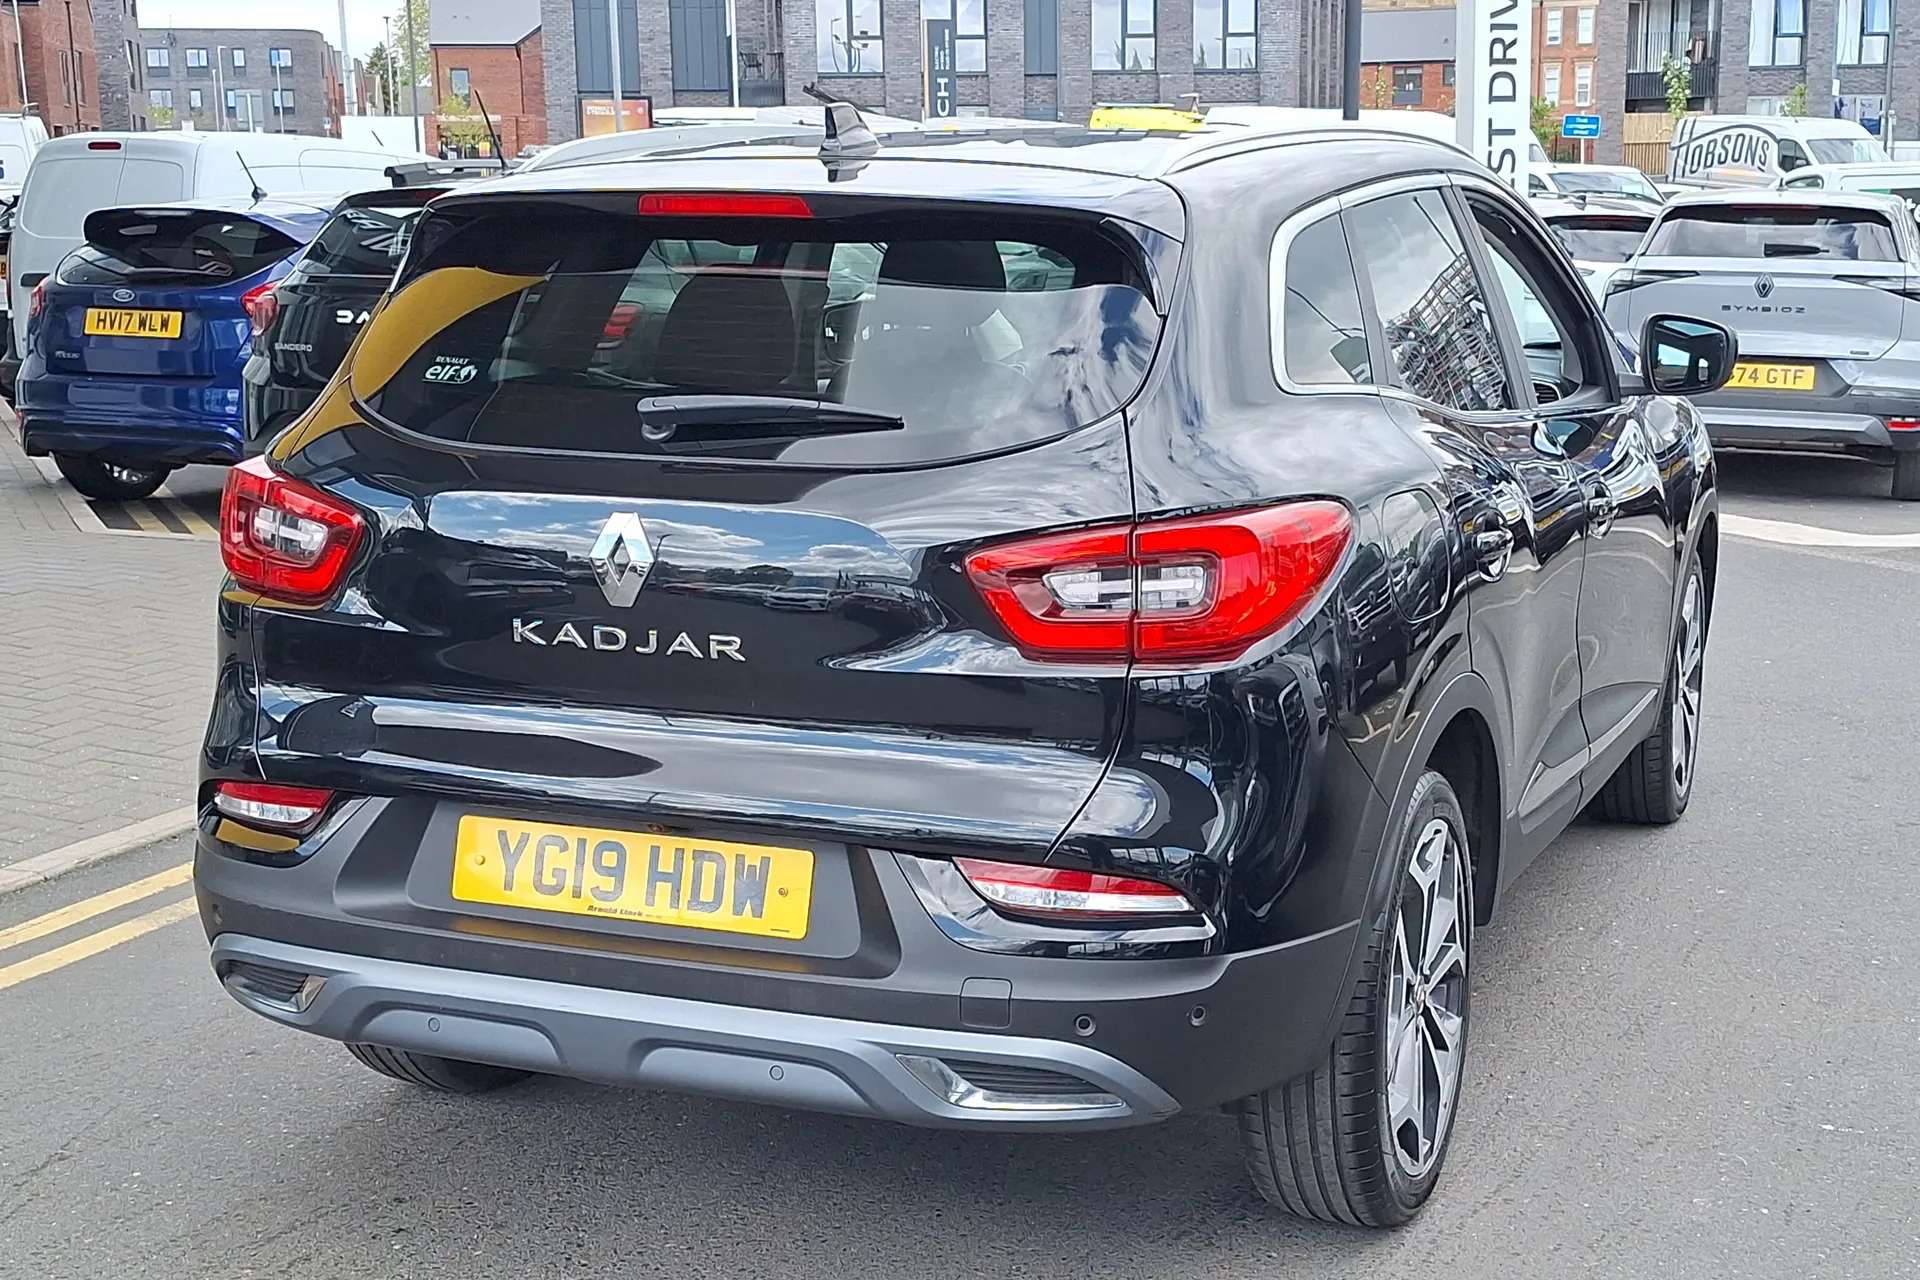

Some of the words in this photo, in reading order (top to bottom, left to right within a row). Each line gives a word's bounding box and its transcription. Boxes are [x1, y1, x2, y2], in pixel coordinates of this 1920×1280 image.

[1487, 117, 1516, 189] ST
[1670, 119, 1770, 182] HOBSONS
[1721, 304, 1807, 314] SYMBIOZ
[96, 311, 135, 332] HV17
[138, 313, 170, 333] WLW
[274, 342, 313, 352] SANDERO
[435, 356, 470, 364] RENAULT
[1730, 367, 1760, 384] 74
[1766, 368, 1805, 385] GTF
[511, 618, 747, 662] KADJAR
[496, 829, 629, 902] YG19
[644, 845, 771, 919] HDW
